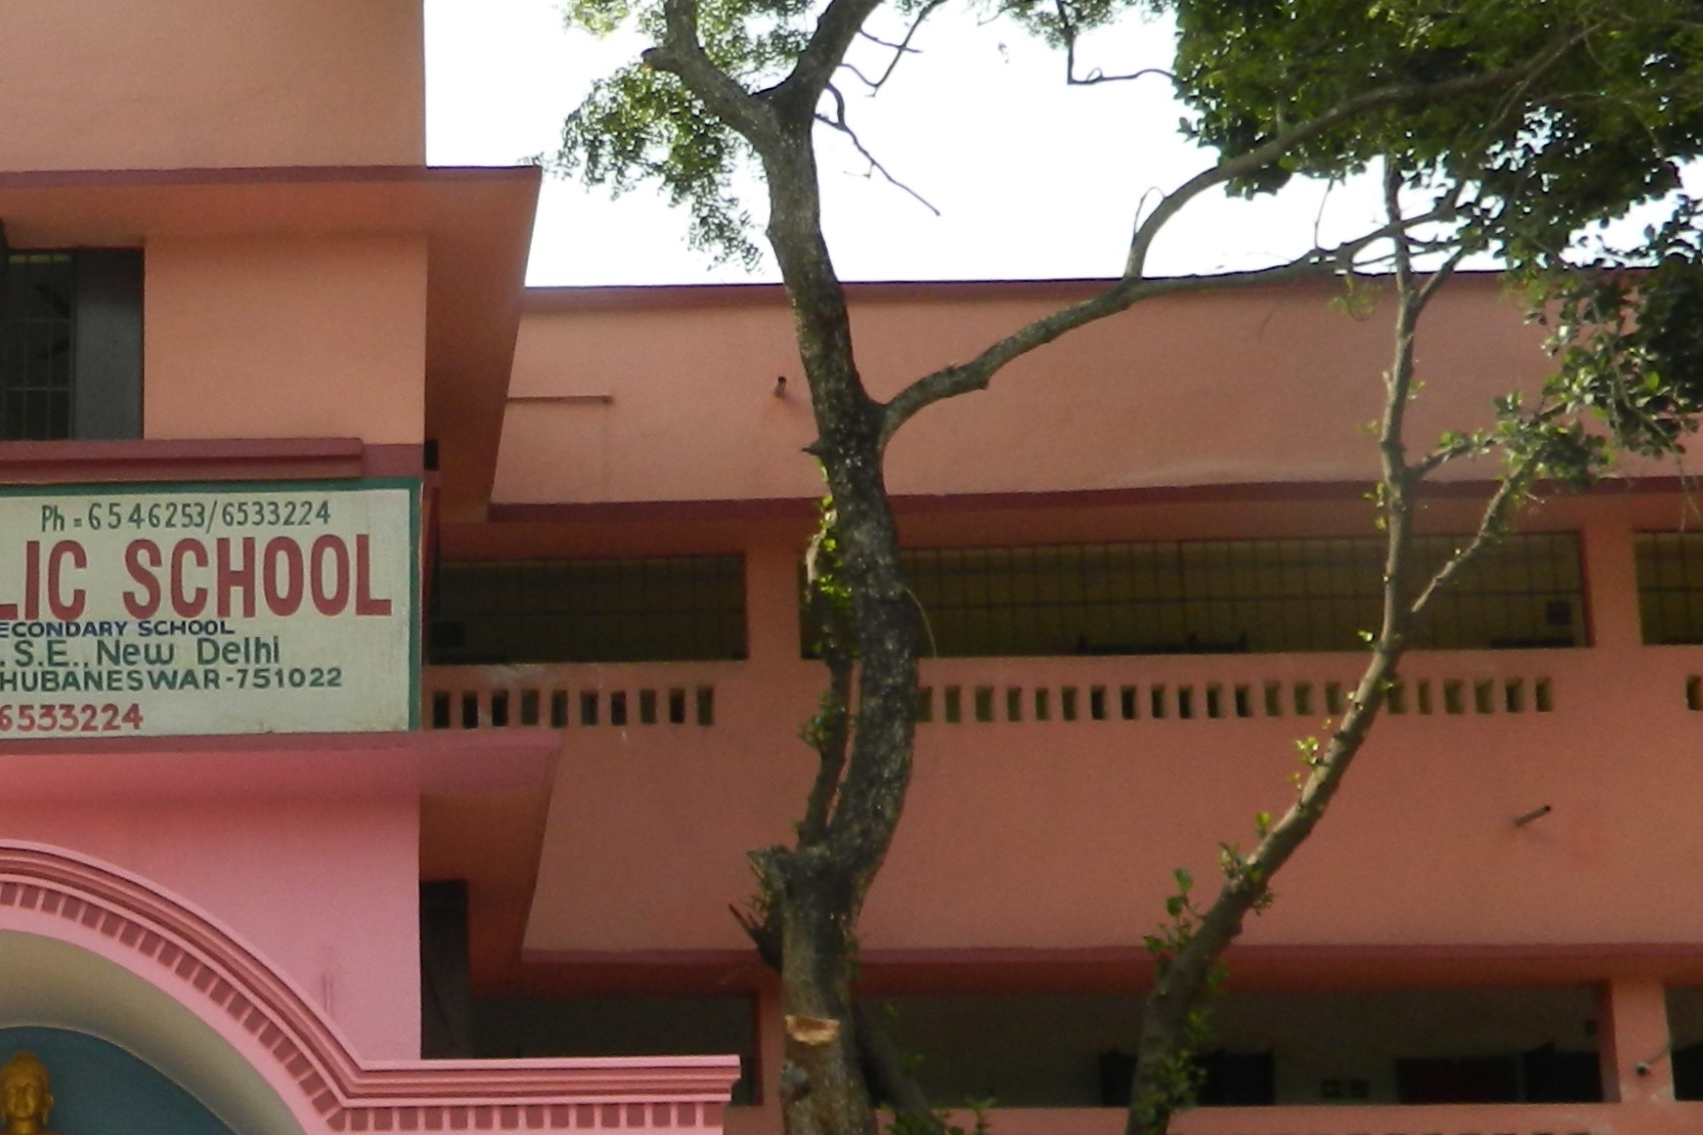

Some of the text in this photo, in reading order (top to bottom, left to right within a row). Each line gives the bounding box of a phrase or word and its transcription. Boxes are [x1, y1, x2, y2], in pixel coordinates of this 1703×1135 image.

[123, 533, 392, 620] SCHOOL
[138, 620, 236, 637] SCHOOL
[98, 638, 175, 667] New
[197, 636, 281, 665] Delhi
